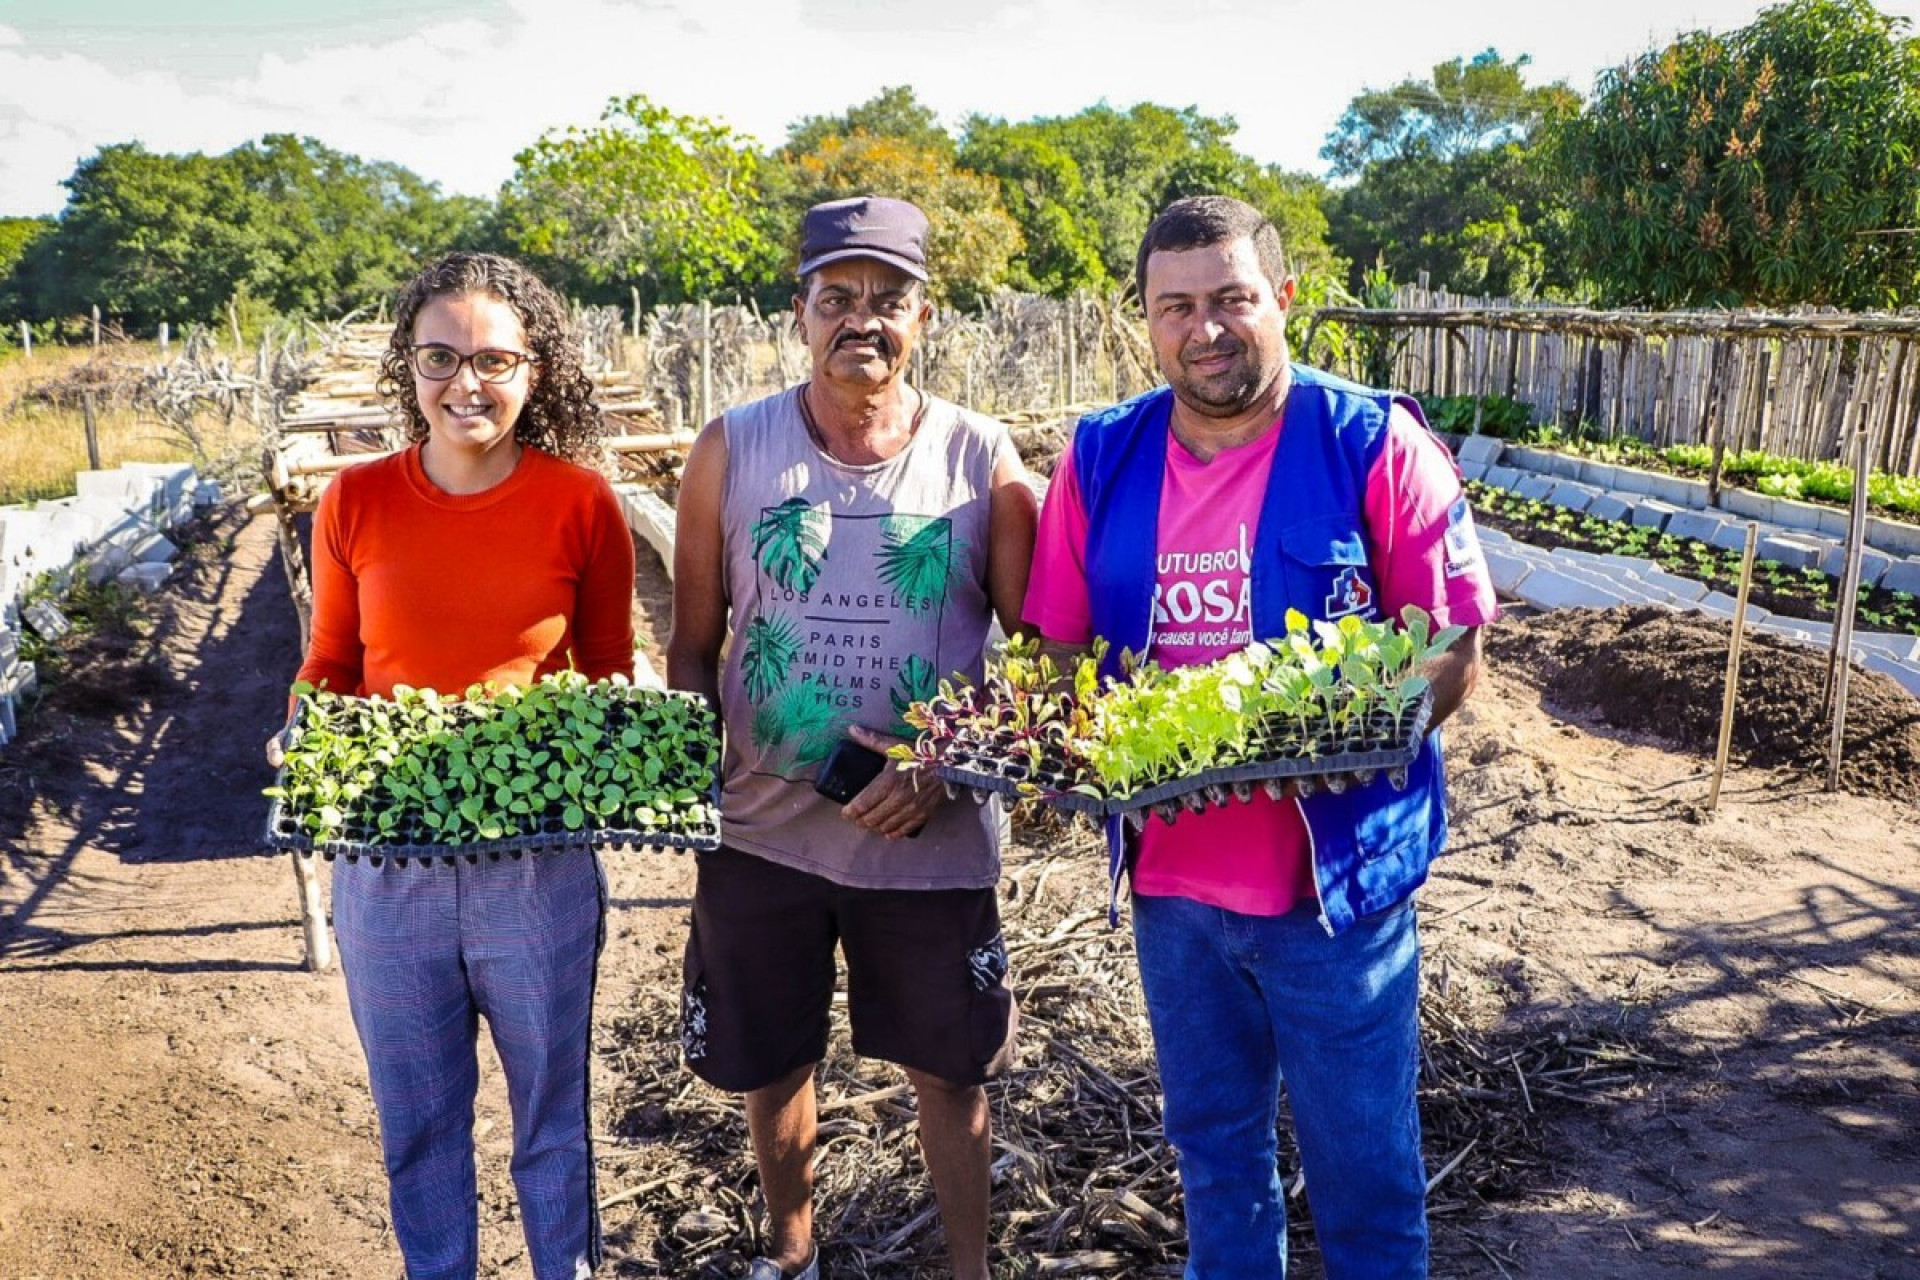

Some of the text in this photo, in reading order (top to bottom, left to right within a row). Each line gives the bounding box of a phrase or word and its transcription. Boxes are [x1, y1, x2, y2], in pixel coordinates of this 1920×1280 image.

[1157, 549, 1238, 574] UTUBRO
[770, 588, 931, 610] LOS ANGELES
[810, 631, 882, 649] PARIS
[1157, 631, 1195, 646] causa
[789, 650, 900, 670] AMID THE
[802, 671, 882, 690] PALMS
